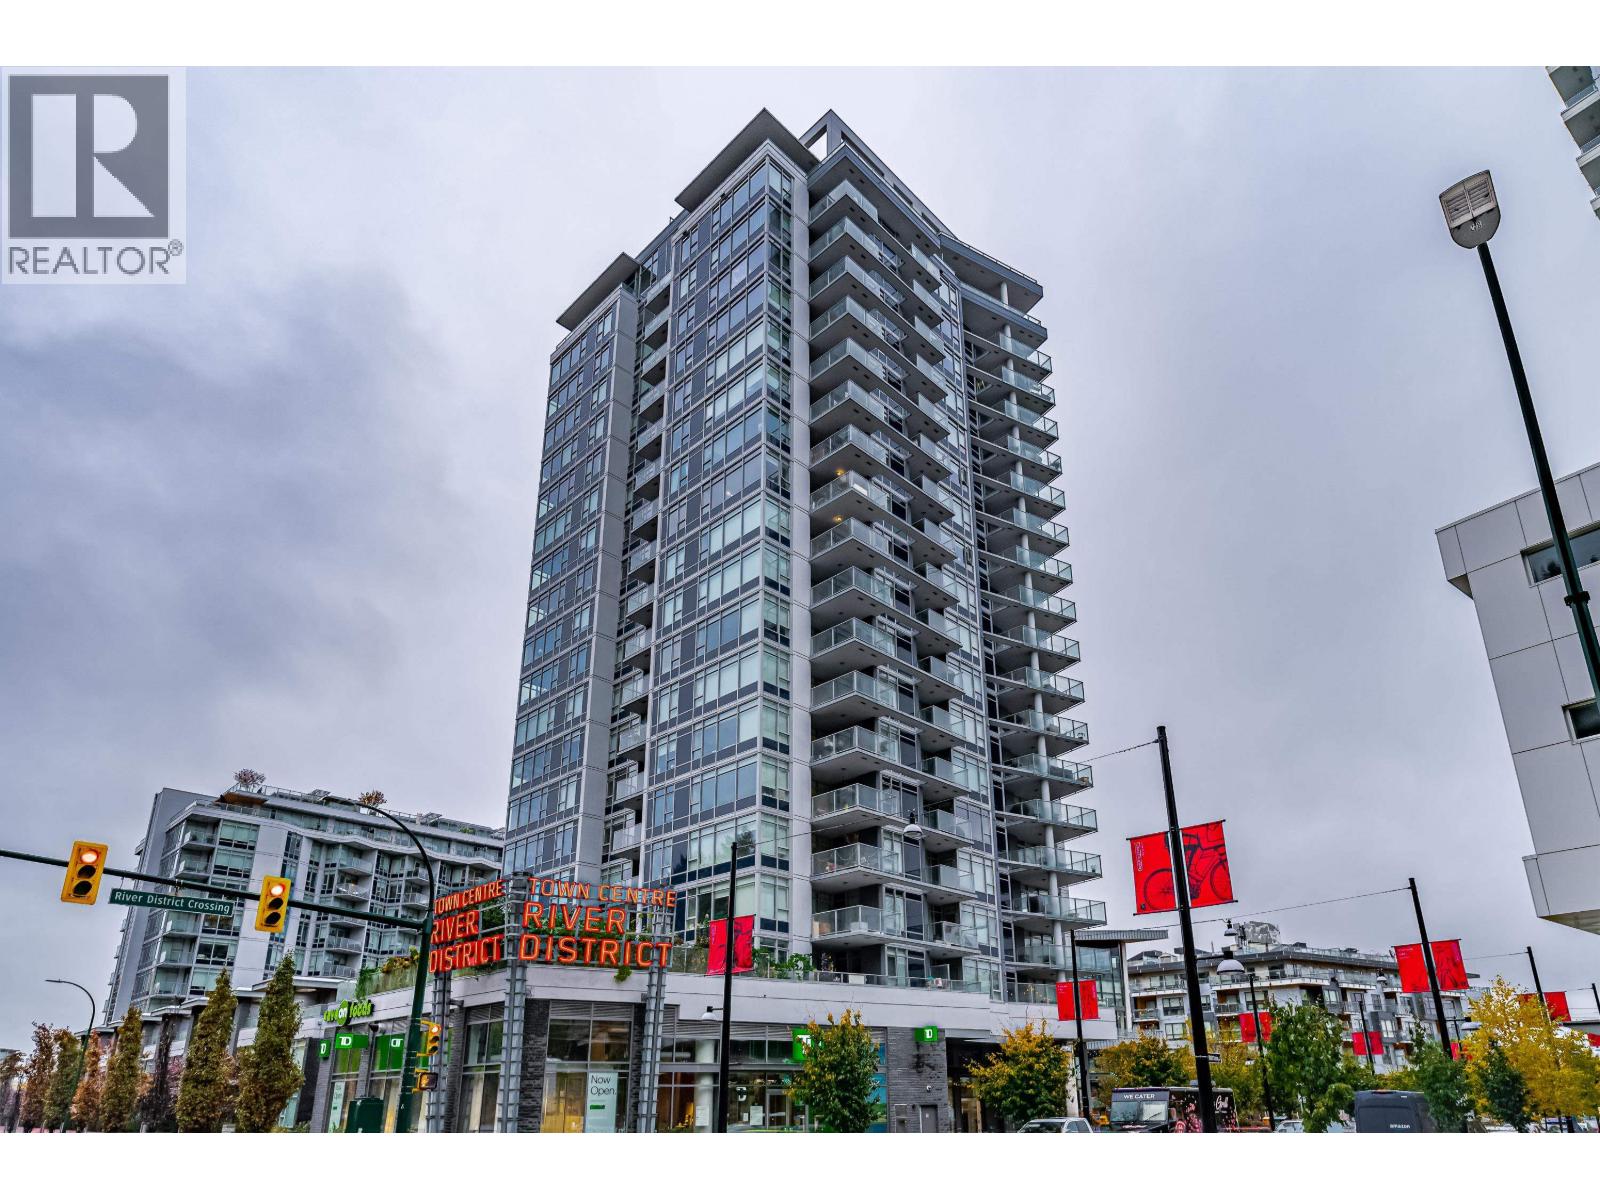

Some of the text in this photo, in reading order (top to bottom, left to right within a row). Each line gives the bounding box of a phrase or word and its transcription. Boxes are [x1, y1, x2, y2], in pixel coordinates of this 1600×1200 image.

[114, 891, 230, 914] River District Crossing
[434, 879, 505, 915] TOWN CENTRE
[527, 877, 677, 908] TOWN CENTRE
[431, 909, 480, 944] RIVER
[522, 901, 626, 935] RIVER
[429, 934, 504, 973] DISTRICT
[518, 932, 673, 969] DISTRICT
[591, 1075, 611, 1084] Now
